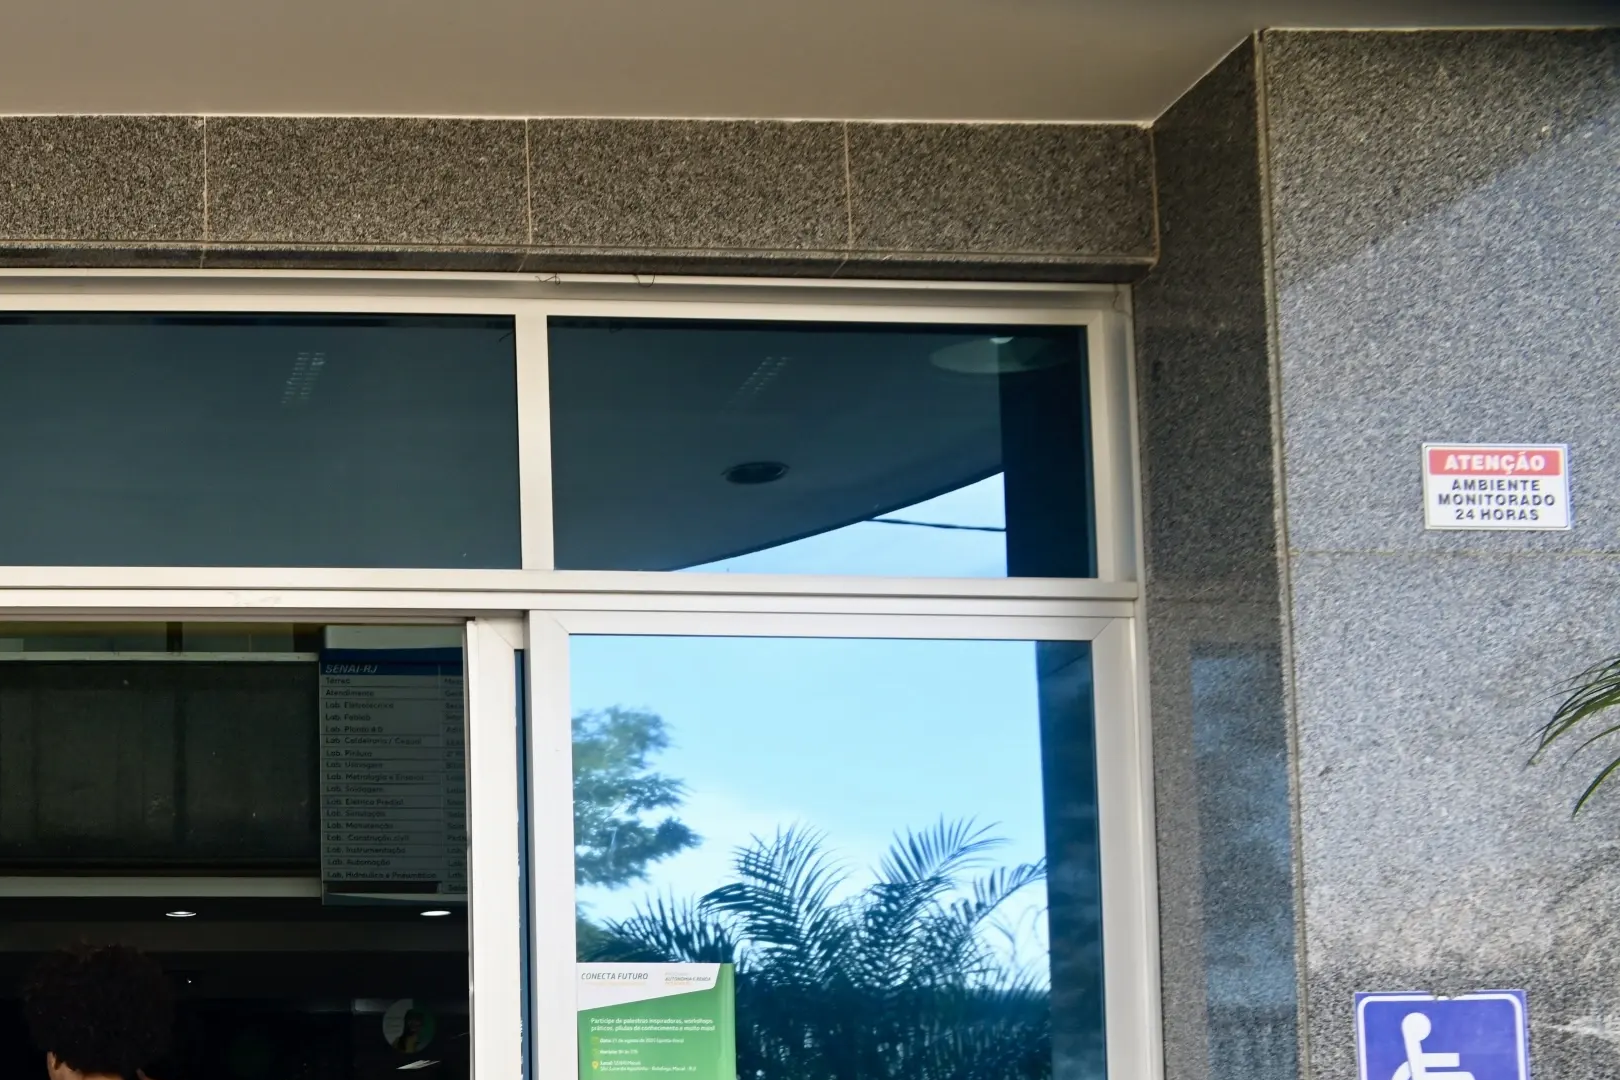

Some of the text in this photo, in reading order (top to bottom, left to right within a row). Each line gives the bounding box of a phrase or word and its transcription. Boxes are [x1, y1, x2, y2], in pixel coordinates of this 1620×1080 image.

[1444, 451, 1546, 475] ATENÇÃO
[1452, 479, 1540, 491] AMBIENTE
[1438, 494, 1555, 506] MONITORADO
[1455, 508, 1539, 521] 24 HORAS
[325, 664, 378, 673] SENAI-RJ
[581, 972, 649, 981] CONECTA FUTURO
[590, 1017, 615, 1025] Participe
